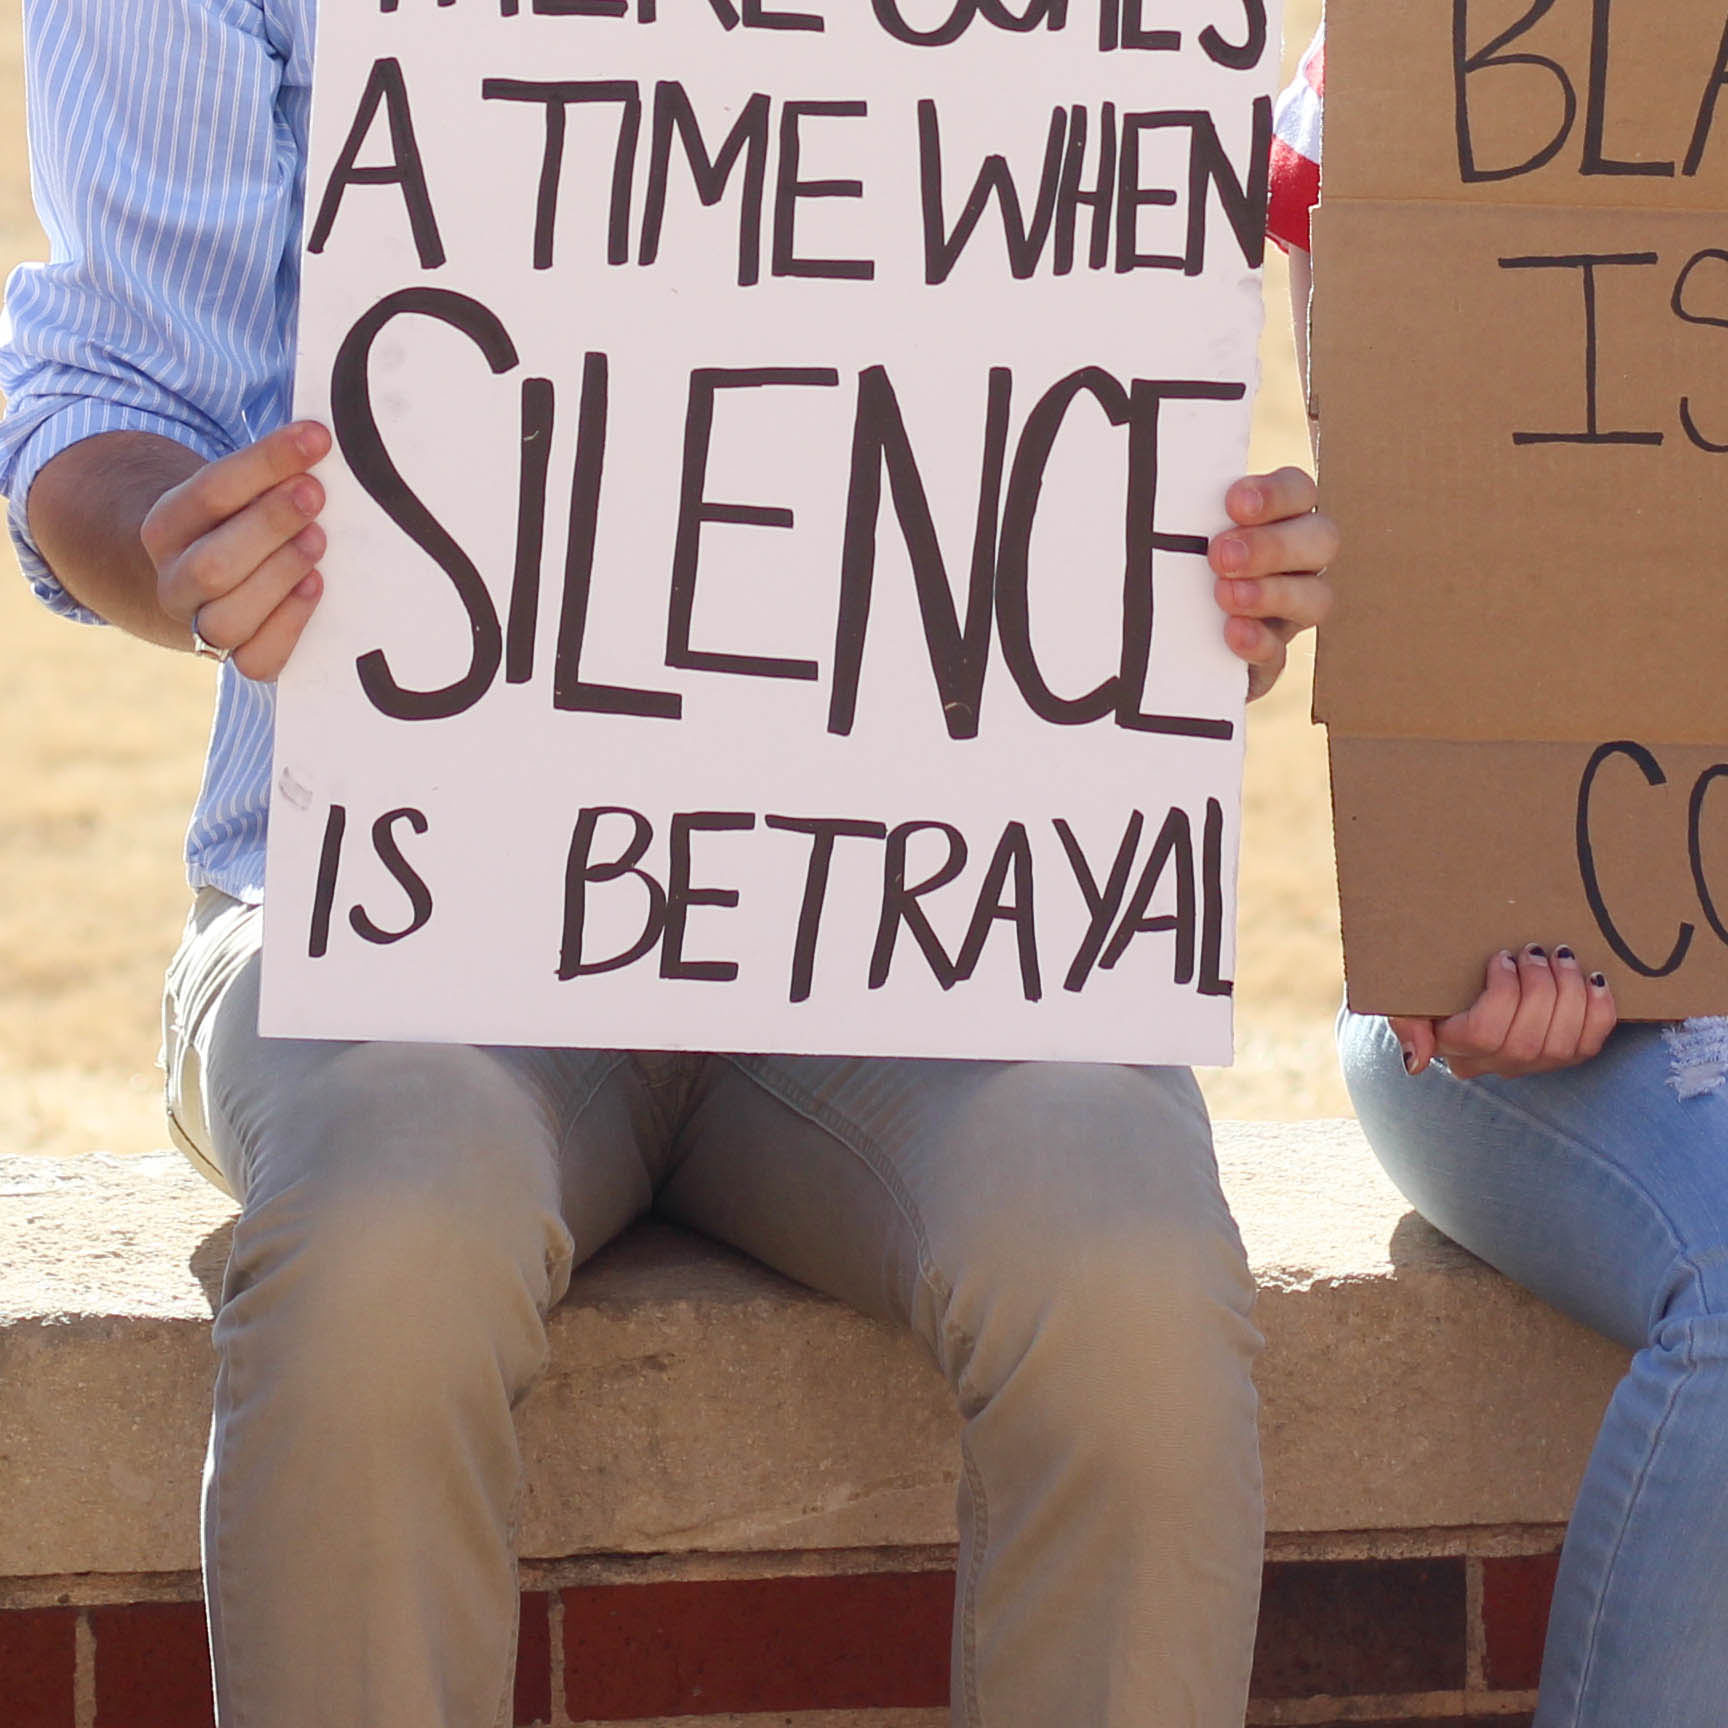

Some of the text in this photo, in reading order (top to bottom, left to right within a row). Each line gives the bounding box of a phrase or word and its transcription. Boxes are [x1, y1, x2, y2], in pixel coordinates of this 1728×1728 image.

[307, 57, 1272, 285] A TIME WHEN
[329, 286, 1246, 741] SILENCE
[307, 797, 1234, 1002] IS BETRAYAL
